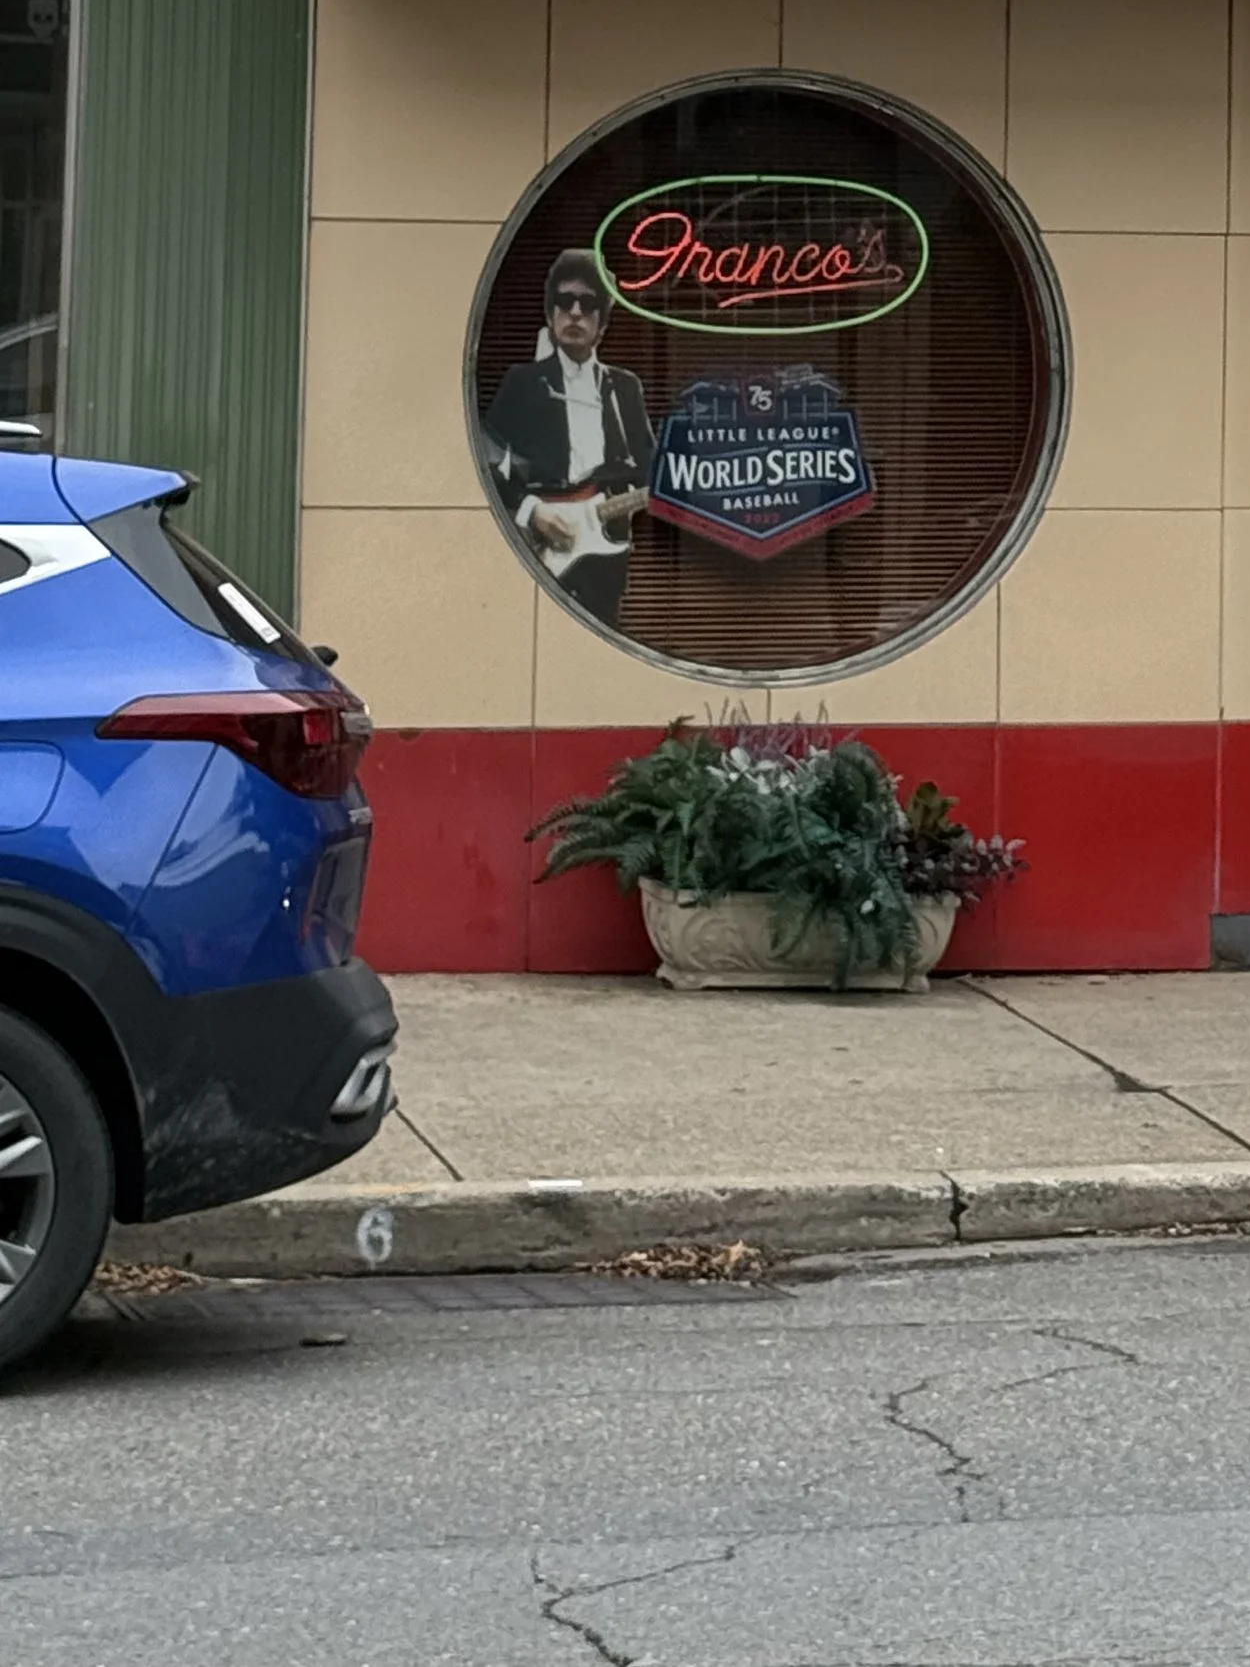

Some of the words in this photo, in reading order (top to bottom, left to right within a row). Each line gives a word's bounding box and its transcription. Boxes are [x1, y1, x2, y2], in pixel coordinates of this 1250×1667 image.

[619, 212, 889, 291] Franco's
[749, 386, 773, 412] 75
[687, 428, 748, 444] LITTLE
[666, 451, 764, 492] WORLD
[766, 447, 856, 486] SERIES
[722, 492, 800, 511] BASEBALL
